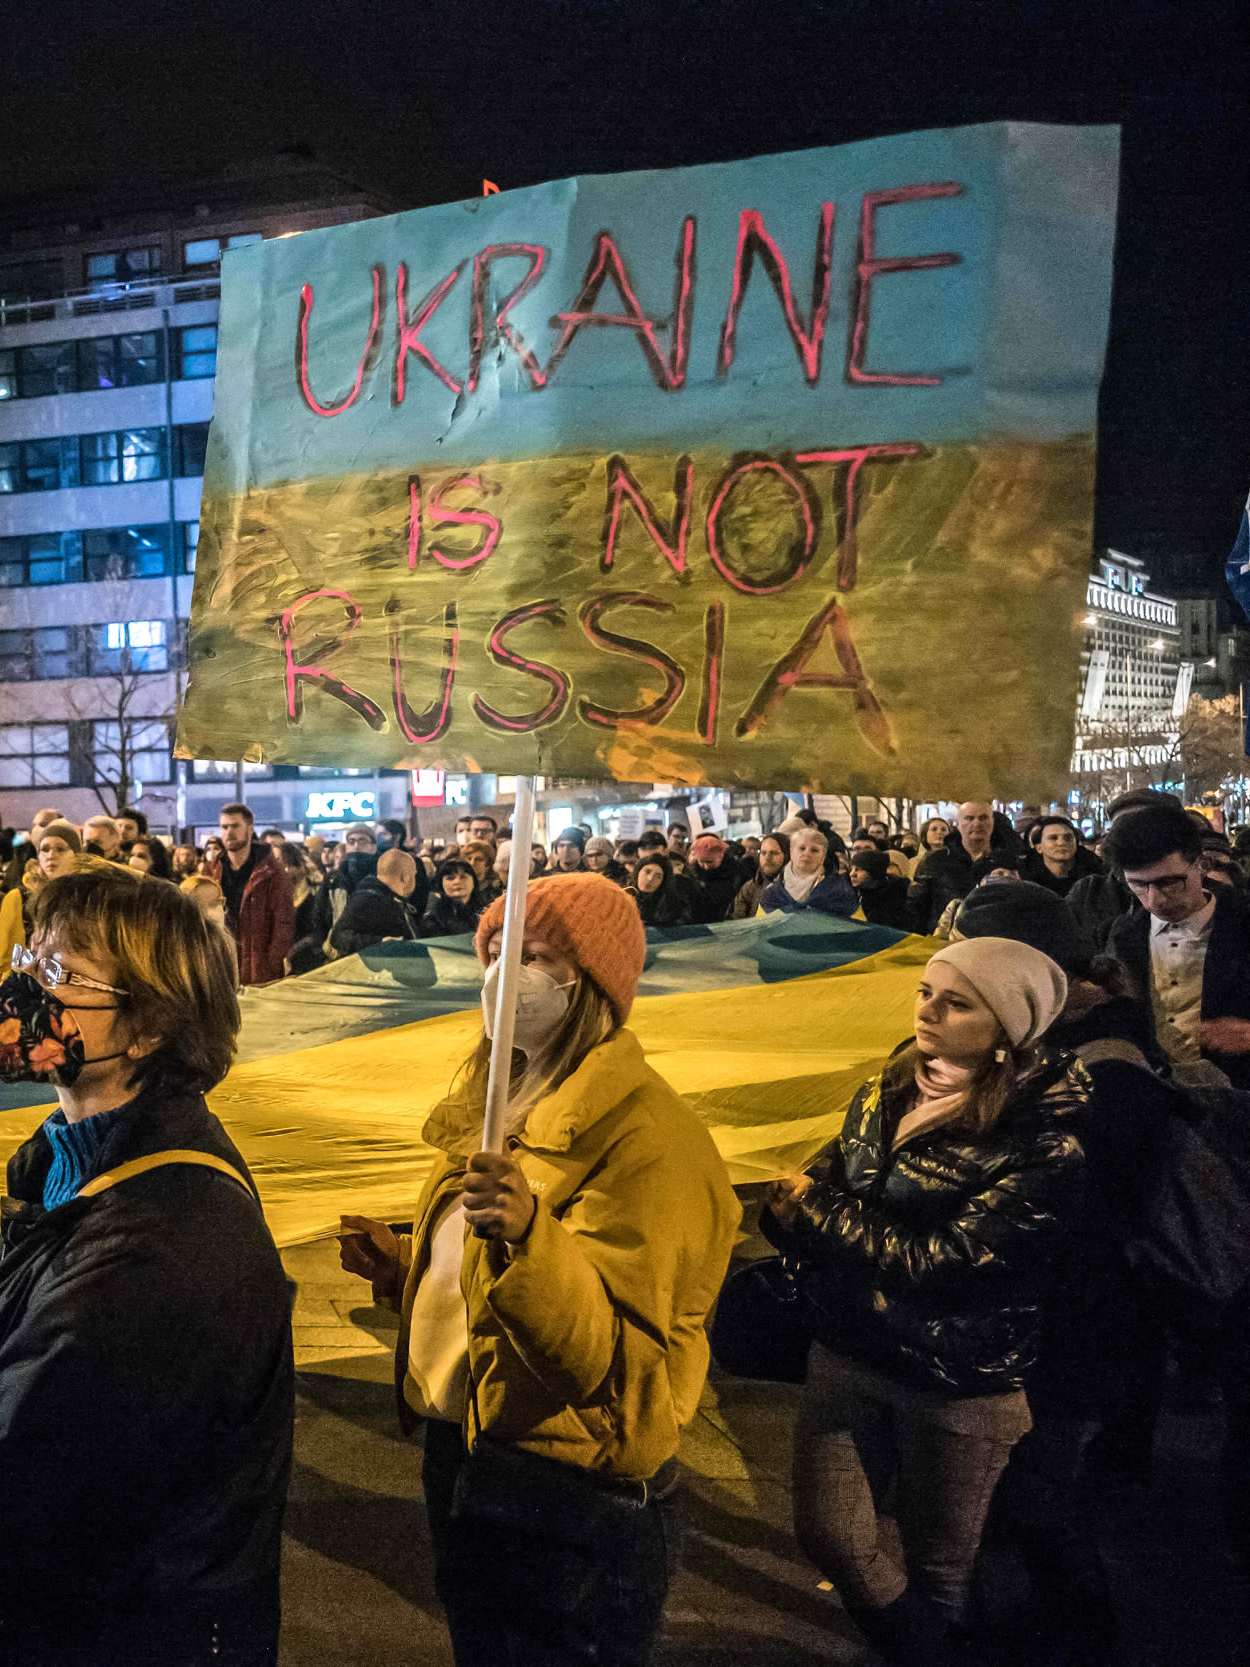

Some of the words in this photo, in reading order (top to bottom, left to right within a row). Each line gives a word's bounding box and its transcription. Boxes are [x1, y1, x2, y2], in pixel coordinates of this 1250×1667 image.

[295, 181, 967, 418] UKRAINE
[406, 458, 502, 572] IS
[599, 442, 930, 597] NOT
[277, 588, 899, 759] RUSSIA
[305, 791, 376, 818] KFC
